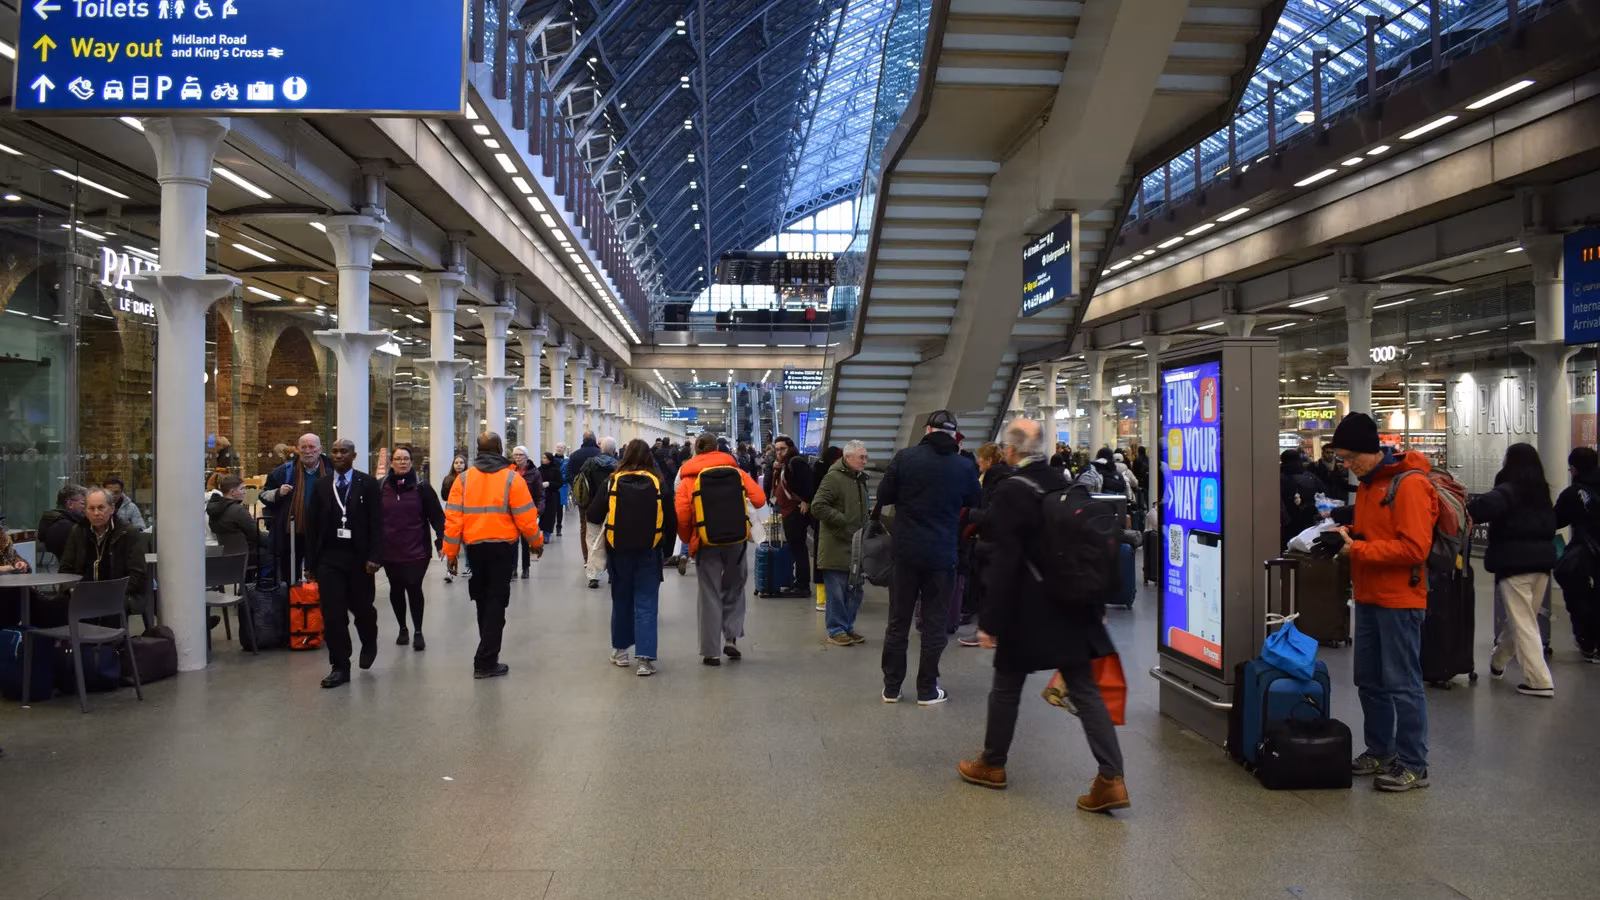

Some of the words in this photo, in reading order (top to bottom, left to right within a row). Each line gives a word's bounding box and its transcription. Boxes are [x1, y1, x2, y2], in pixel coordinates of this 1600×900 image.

[72, 0, 149, 18] Toilets
[172, 34, 216, 45] Midland
[219, 34, 247, 45] Road
[70, 37, 120, 62] Way
[126, 38, 163, 58] out
[171, 47, 192, 58] and
[195, 47, 229, 60] King's
[232, 47, 264, 58] Cross
[786, 252, 834, 260] SEARCYS
[119, 297, 131, 312] LE
[1167, 380, 1193, 425] FIND
[1184, 426, 1217, 472] YOUR
[1173, 475, 1198, 520] WAY
